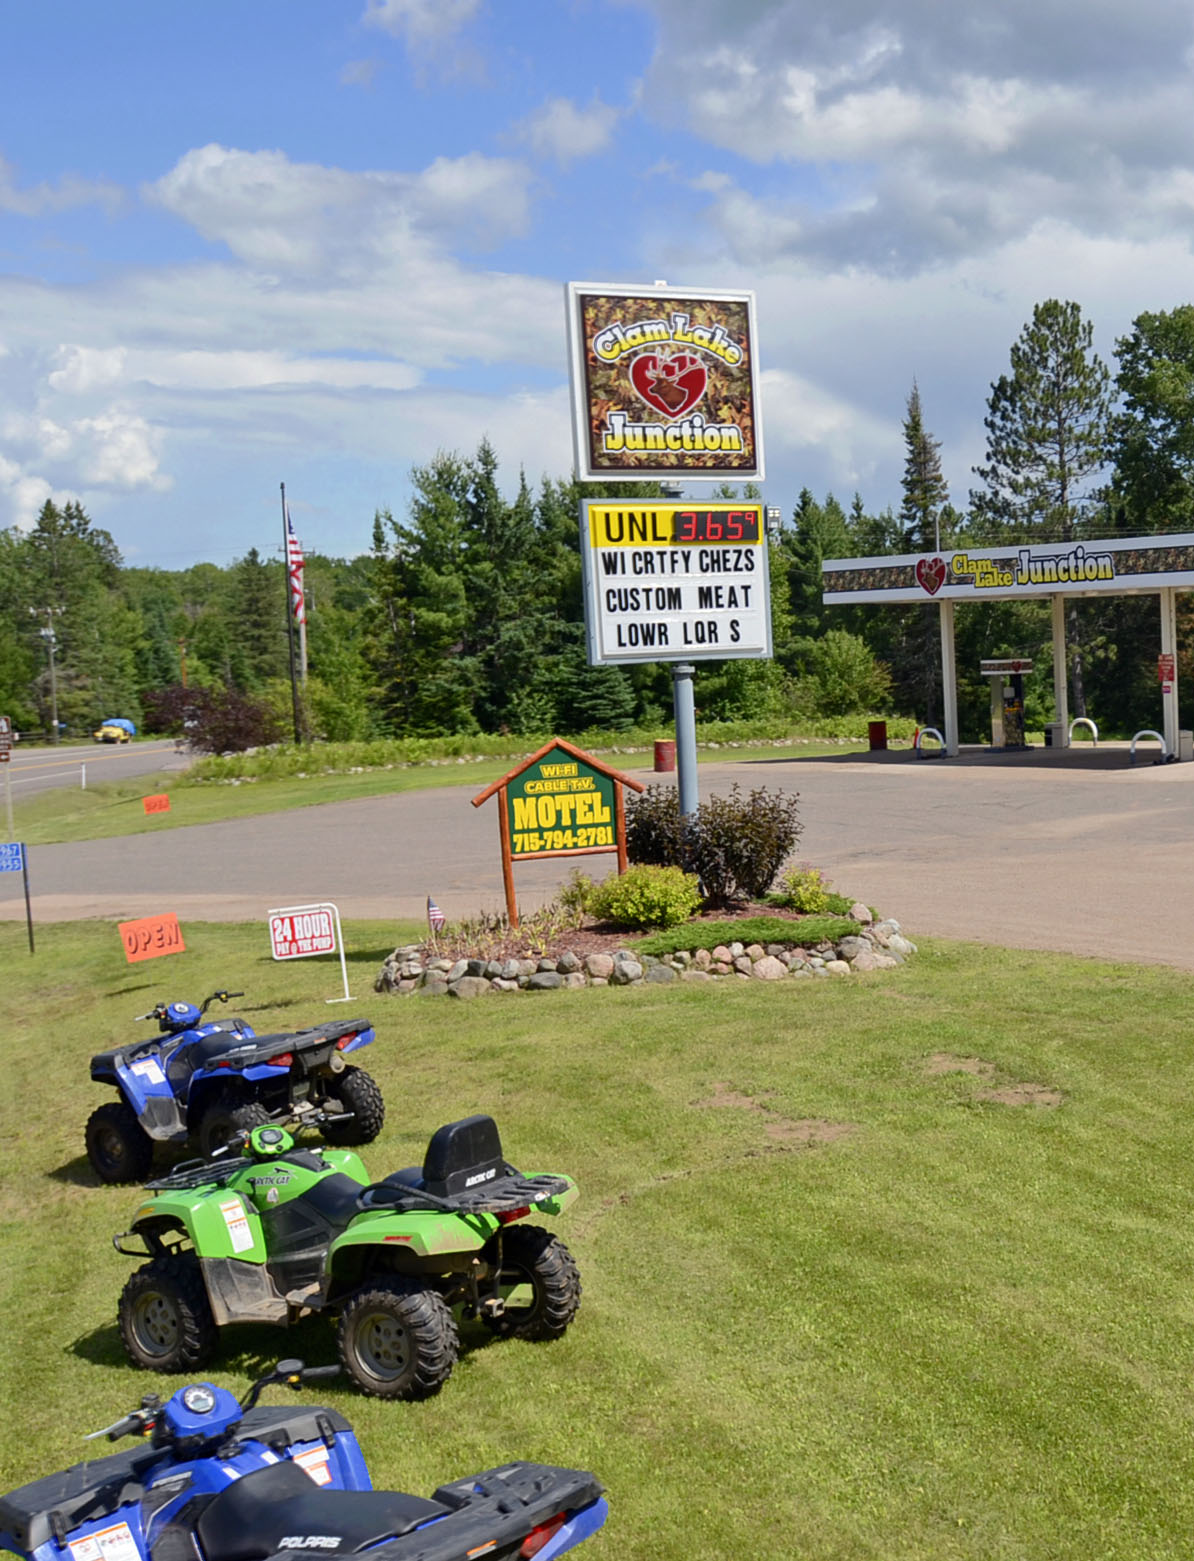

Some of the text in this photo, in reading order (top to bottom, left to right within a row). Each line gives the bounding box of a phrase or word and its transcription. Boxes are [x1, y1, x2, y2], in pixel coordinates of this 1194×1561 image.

[595, 314, 742, 364] Clam Lake
[604, 413, 742, 452] Junction
[604, 512, 667, 543] UNL
[602, 549, 755, 575] WI CRTFY CHEZS
[952, 545, 1113, 585] Clam Junction
[974, 570, 1014, 589] Lake
[606, 585, 752, 613] CUSTOM MEAT
[617, 623, 669, 648] LOWR
[683, 620, 719, 645] LQR
[524, 779, 568, 795] CABLE
[512, 792, 611, 831] MOTEL
[512, 825, 614, 853] 715-794-2781
[126, 922, 179, 954] OPEN
[273, 913, 331, 942] 24 HOUR
[278, 1535, 342, 1549] POLARIS
